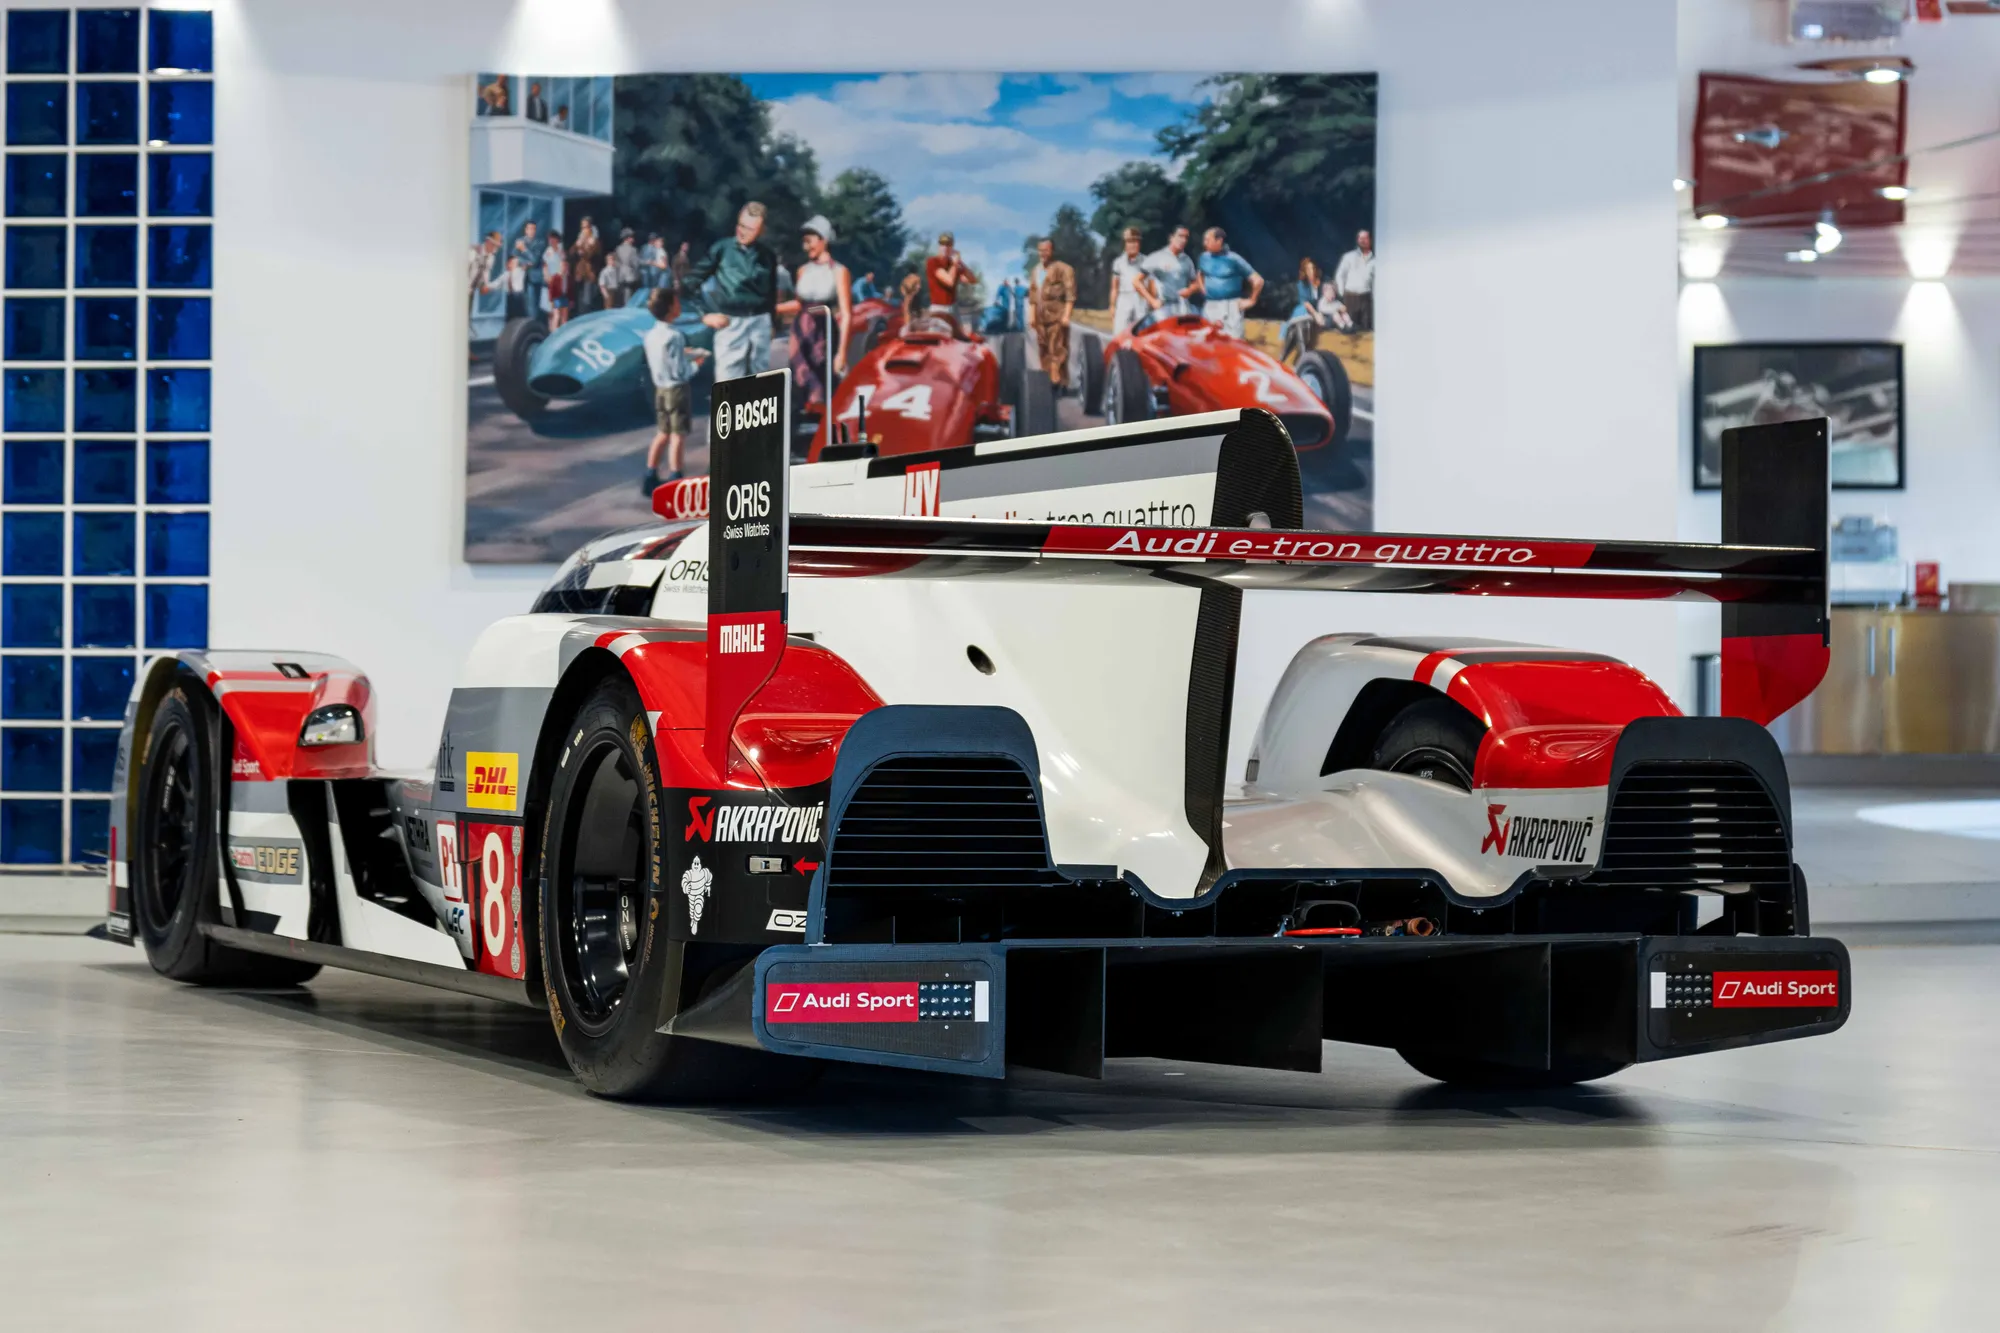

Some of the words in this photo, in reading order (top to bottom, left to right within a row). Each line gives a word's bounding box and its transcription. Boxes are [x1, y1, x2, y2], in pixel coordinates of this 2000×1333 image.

[571, 339, 617, 371] 18
[837, 384, 933, 421] 14
[1239, 370, 1289, 403] 2
[735, 396, 778, 431] BOSCH
[726, 480, 771, 521] ORIS
[726, 525, 744, 540] Swiss
[744, 522, 770, 539] Watches
[1106, 530, 1219, 554] Audi
[1228, 536, 1361, 559] e-tron
[1374, 542, 1536, 564] quattro
[719, 622, 765, 654] MAHLE
[473, 766, 510, 795] DHL
[644, 762, 661, 886] MICHELIN
[256, 845, 300, 876] EDGE
[440, 835, 457, 888] P1
[483, 831, 505, 957] 8
[802, 992, 850, 1008] Audi
[856, 992, 915, 1011] Sport
[1743, 981, 1782, 995] Audi
[1787, 980, 1836, 998] Sport
